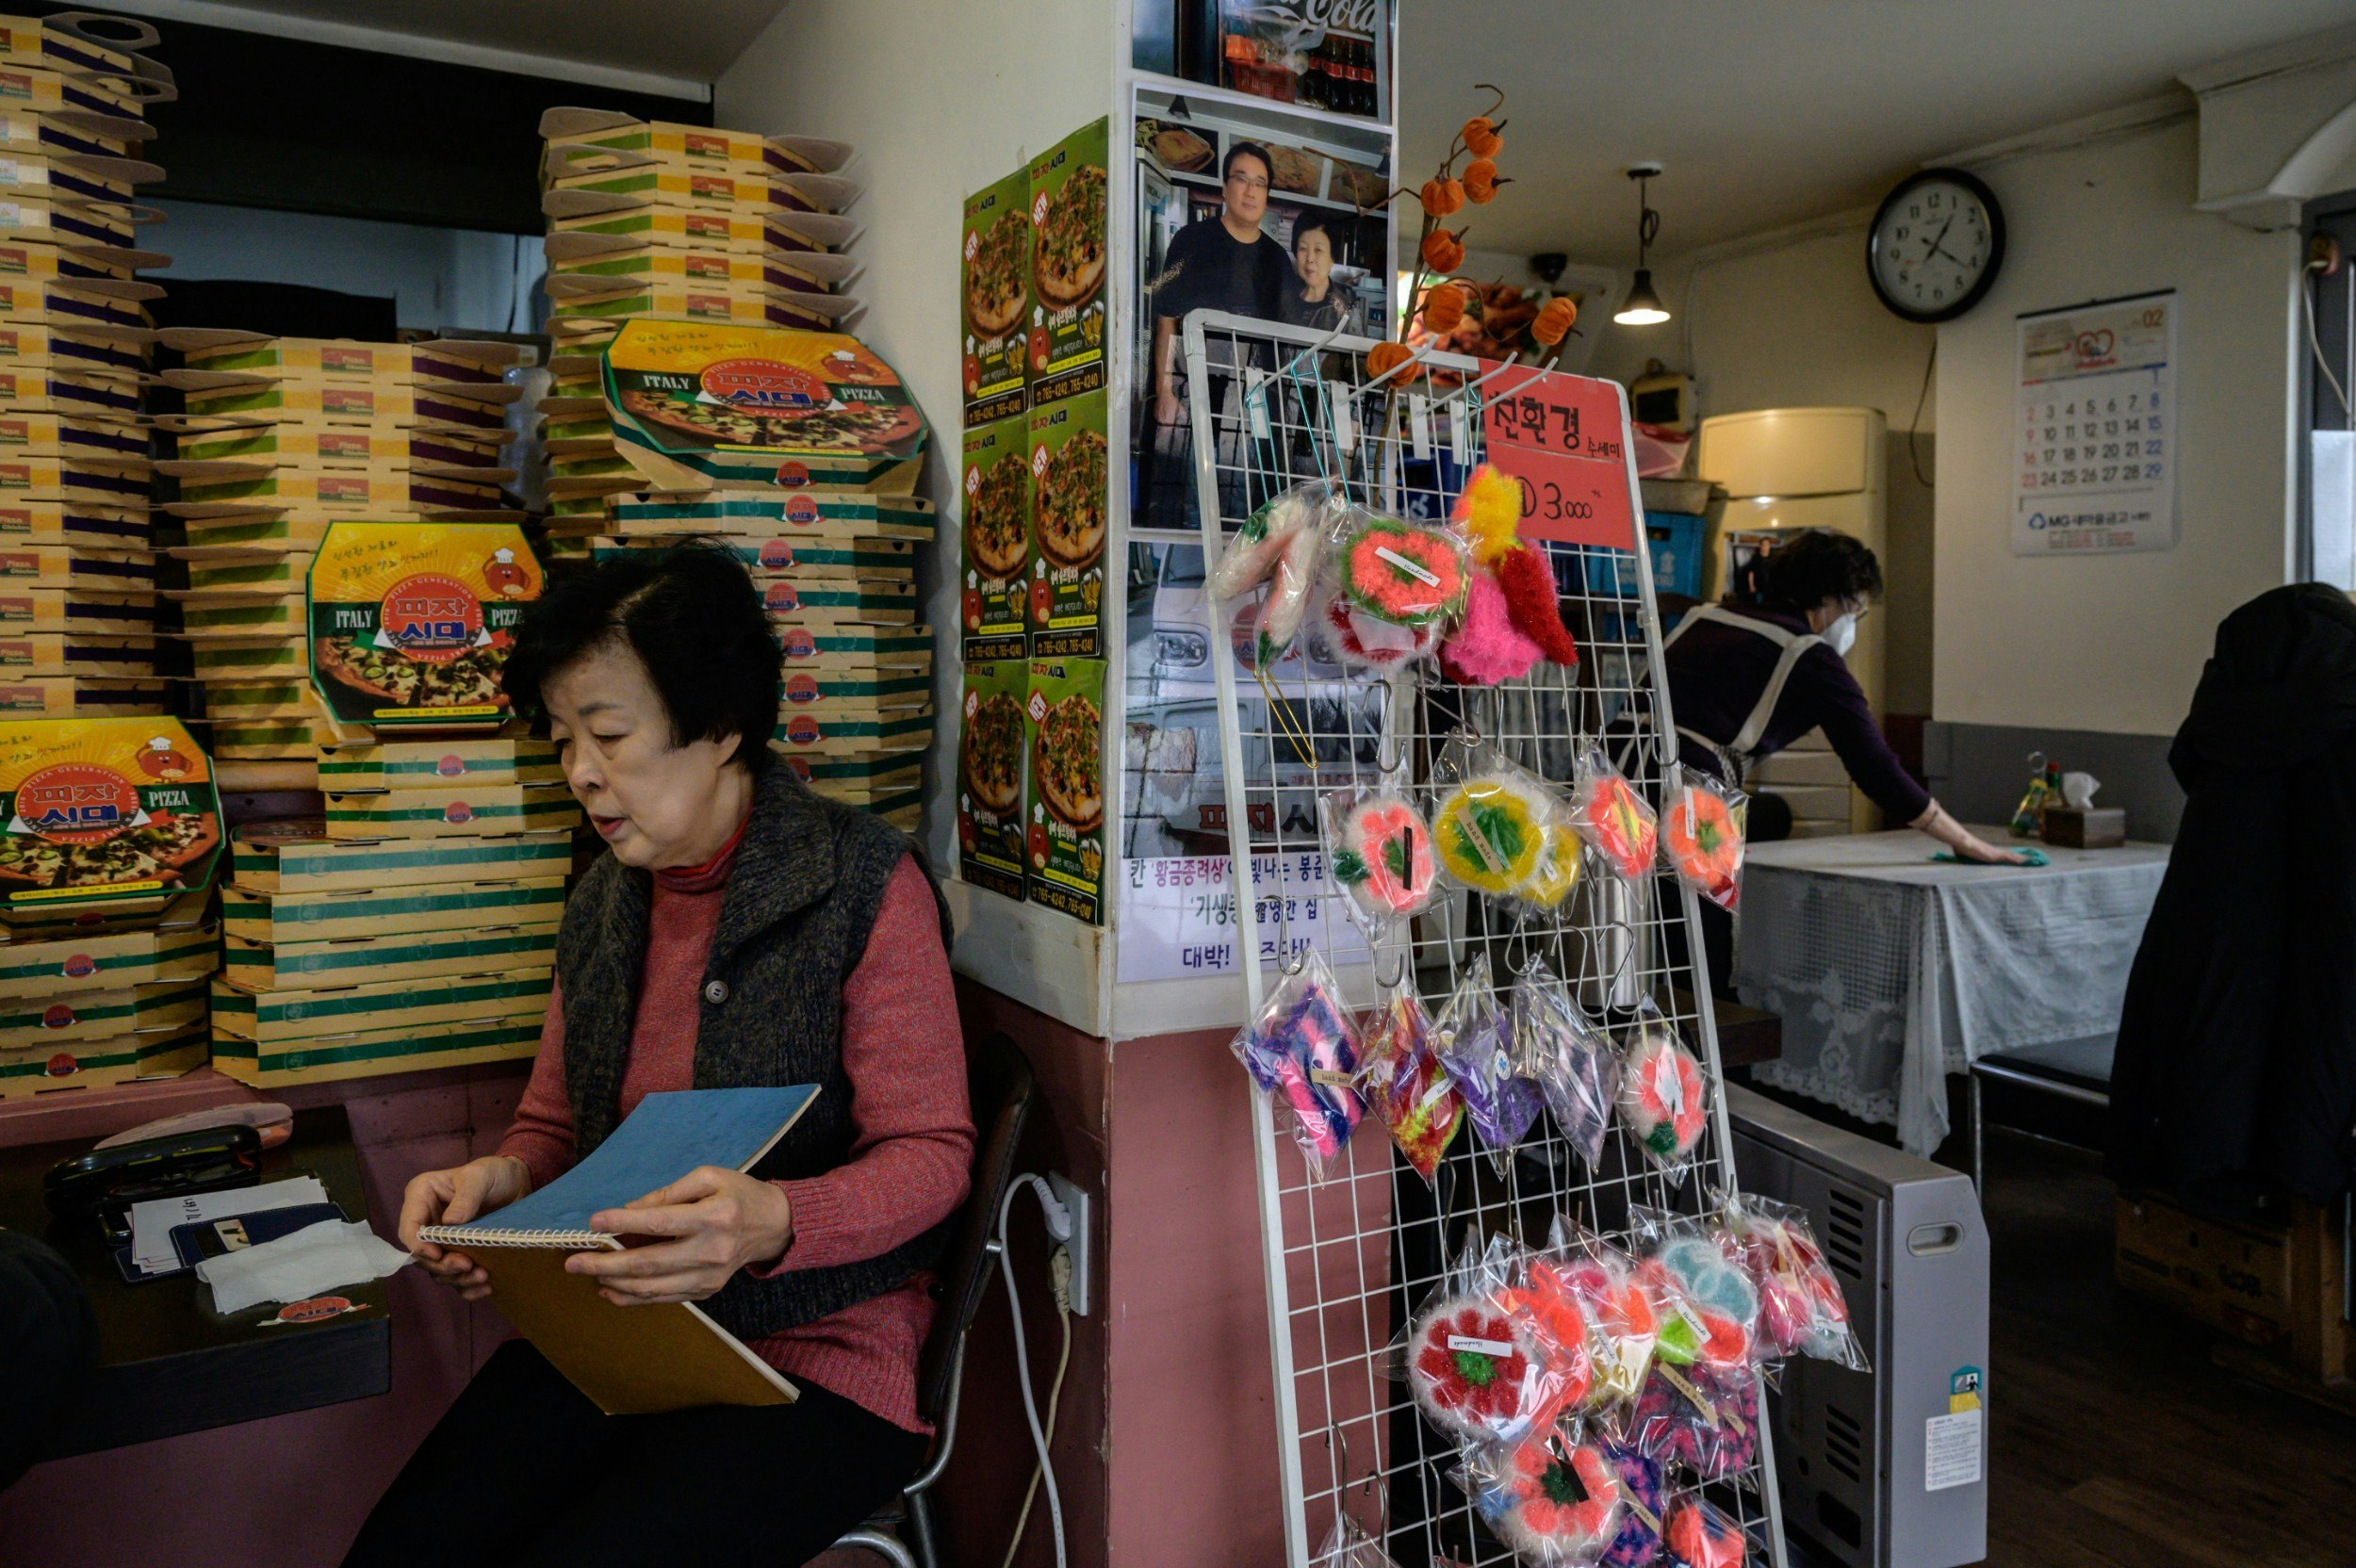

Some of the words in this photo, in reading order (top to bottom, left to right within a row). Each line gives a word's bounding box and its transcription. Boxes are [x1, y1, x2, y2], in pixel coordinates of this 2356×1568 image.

[1033, 191, 1048, 226] NEW
[1928, 192, 1939, 207] 12
[1952, 196, 1957, 209] 1
[1910, 205, 1921, 219] 11
[1968, 207, 1975, 223] 2
[1896, 227, 1909, 240] 10
[1975, 230, 1983, 244] 3
[965, 230, 978, 262] NEW
[1890, 249, 1900, 260] 9
[1971, 256, 1977, 268] 4
[1915, 284, 1923, 297] 7
[1934, 288, 1943, 299] 6
[2143, 309, 2165, 329] 02
[643, 374, 690, 390] ITALY
[719, 372, 809, 391] 피자
[728, 389, 813, 406] 시대
[840, 386, 885, 401] PIZZA
[2047, 405, 2054, 420] 3
[2066, 402, 2075, 416] 4
[2086, 400, 2096, 415] 5
[2107, 398, 2117, 413] 6
[2128, 395, 2138, 411] 7
[1489, 390, 1580, 450] 친환경
[1587, 435, 1621, 459] 수세미
[2044, 426, 2056, 441] 10
[2066, 424, 2075, 439] 11
[2084, 423, 2096, 438] 12
[2104, 420, 2119, 435] 13
[2125, 417, 2139, 432] 14
[2148, 416, 2162, 431] 15
[1032, 445, 1048, 478] NEW
[2023, 451, 2036, 466] 16
[2043, 449, 2056, 465] 17
[2064, 448, 2076, 463] 18
[2084, 446, 2096, 460] 19
[2102, 444, 2119, 459] 20
[2125, 441, 2139, 457] 21
[2146, 440, 2162, 455] 22
[965, 466, 981, 497] NEW
[2022, 473, 2037, 488] 23
[2040, 471, 2057, 486] 24
[2061, 469, 2077, 484] 25
[2081, 467, 2097, 483] 26
[2102, 466, 2119, 482] 27
[2123, 465, 2140, 481] 28
[2145, 462, 2162, 479] 29
[2048, 514, 2071, 528] MG
[1403, 564, 1434, 581] Handmade
[390, 581, 414, 600] PIZZA
[417, 577, 473, 600] GENERATION
[396, 596, 469, 617] 피자
[335, 609, 372, 629] ITALY
[399, 621, 467, 642] 시대
[965, 689, 978, 720] NEW
[1027, 692, 1047, 722] NEW
[26, 771, 54, 790] PIZZA
[57, 765, 125, 786] GENERATION
[34, 783, 121, 802] 피자
[148, 790, 190, 808] PIZZA
[39, 804, 121, 825] 시대
[1465, 821, 1482, 845] hand
[1478, 841, 1494, 862] made
[1130, 858, 1146, 889] 칸
[1183, 944, 1230, 969] 대박!
[1682, 1310, 1708, 1336] Handmade
[1450, 1339, 1483, 1348] Handmade
